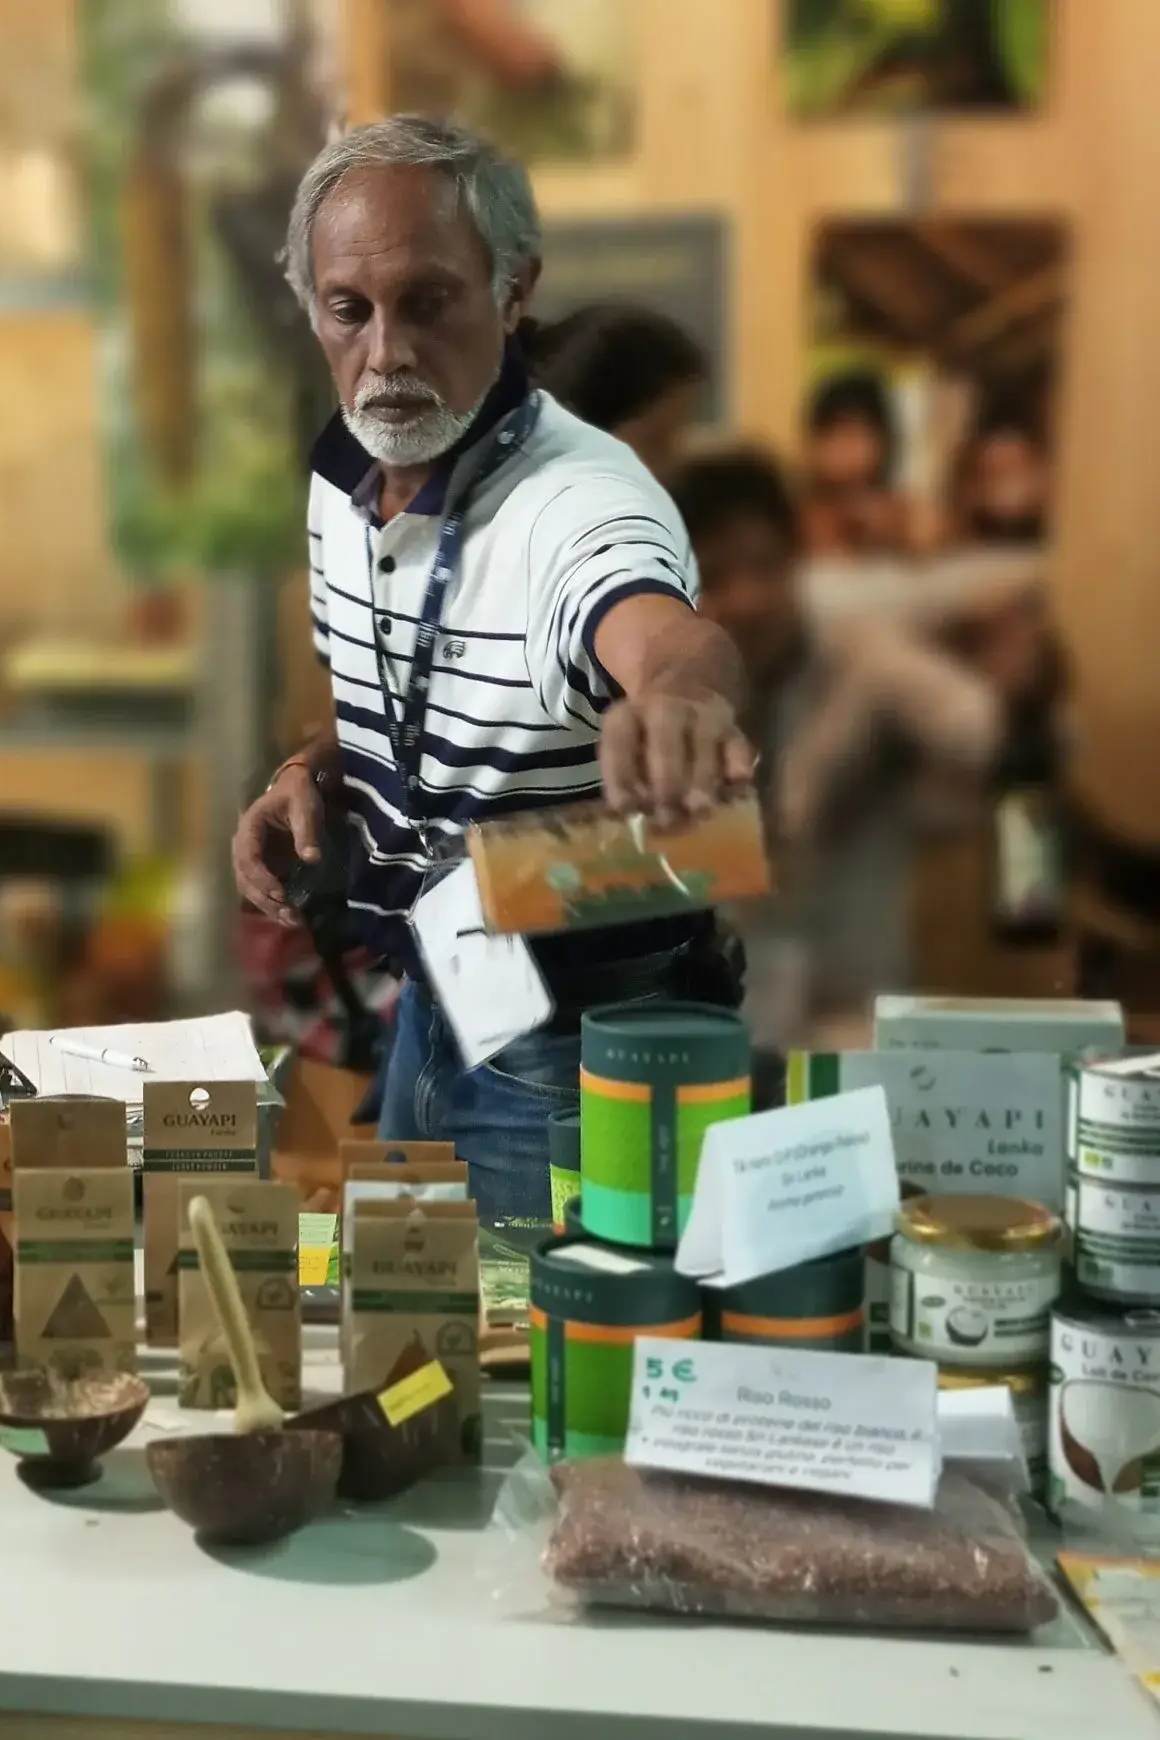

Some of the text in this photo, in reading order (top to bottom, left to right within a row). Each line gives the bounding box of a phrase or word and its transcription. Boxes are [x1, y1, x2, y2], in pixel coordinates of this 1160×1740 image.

[163, 1113, 237, 1127] GUAYAPI
[941, 1159, 964, 1175] de
[969, 1160, 1019, 1177] Coco
[645, 1356, 697, 1383] 5 €
